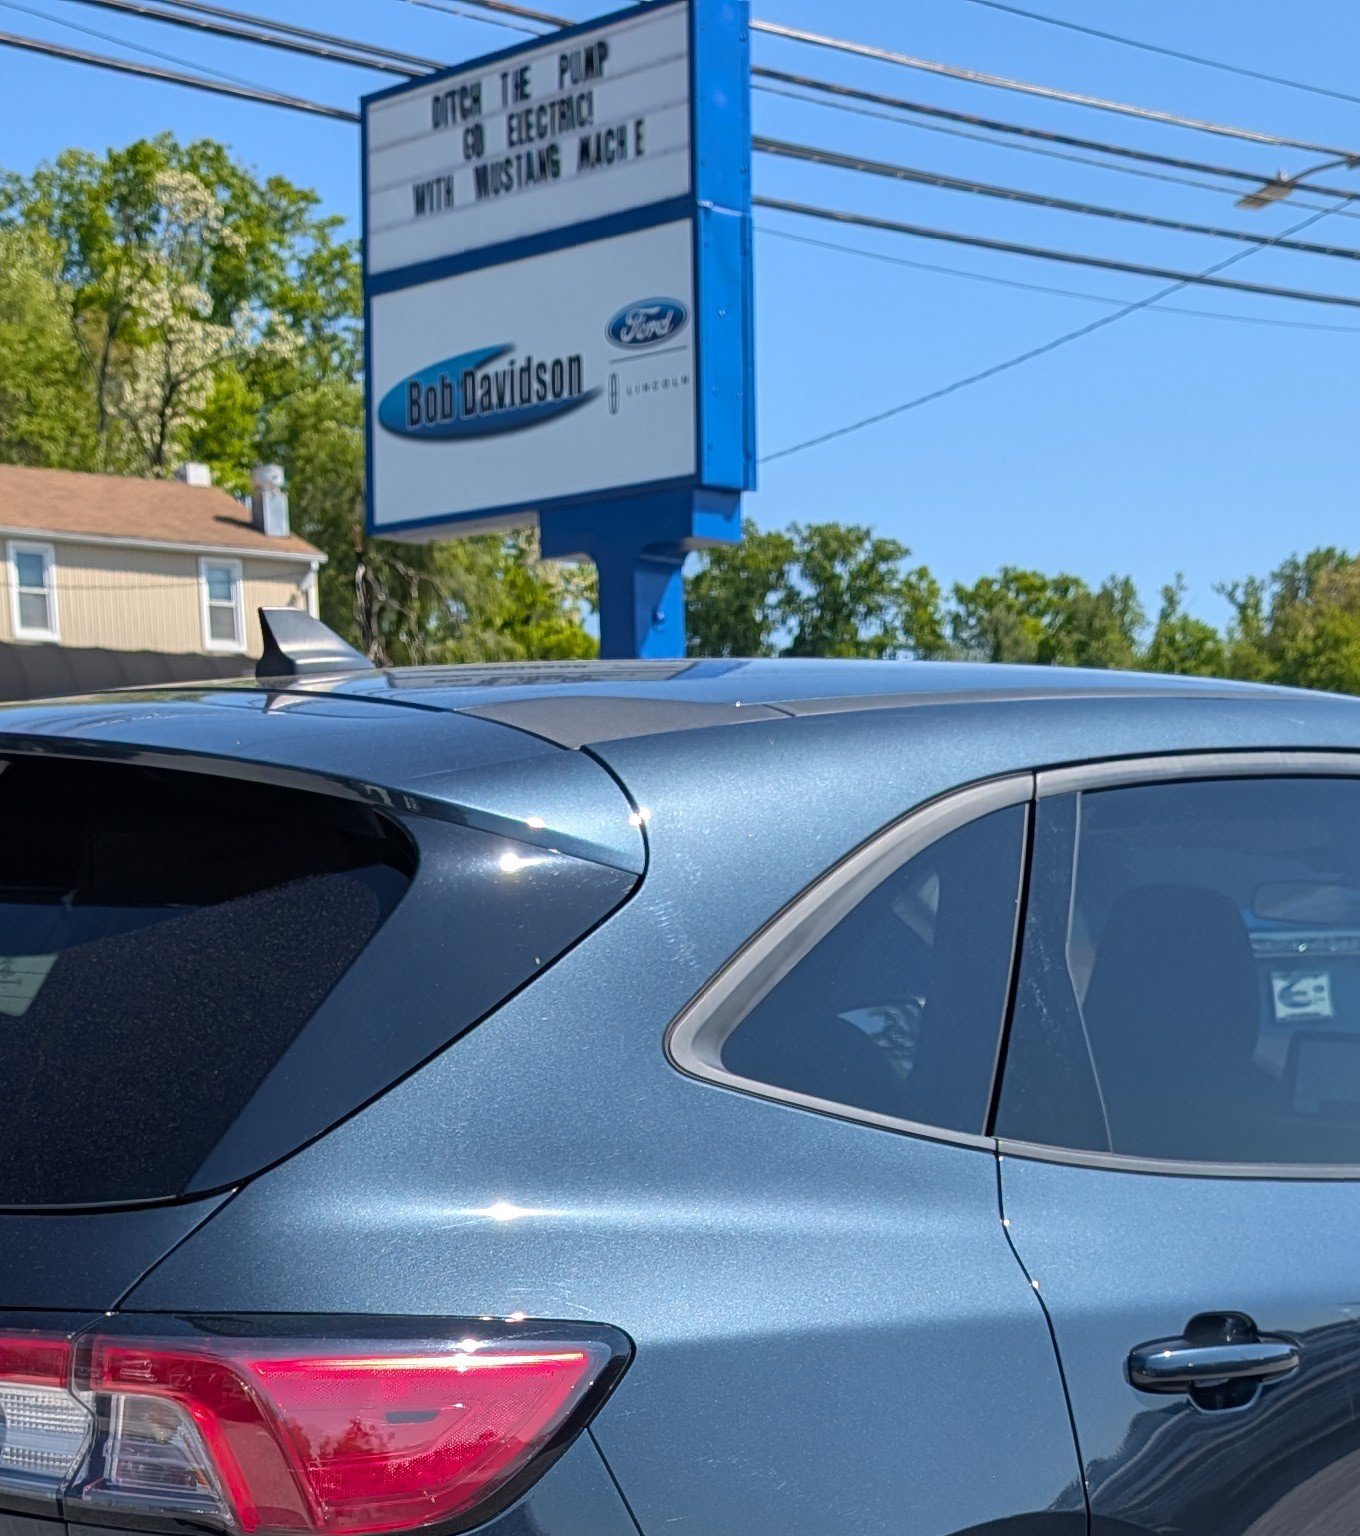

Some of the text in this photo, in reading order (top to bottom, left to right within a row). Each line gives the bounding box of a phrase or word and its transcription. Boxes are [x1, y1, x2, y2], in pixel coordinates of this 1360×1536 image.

[432, 40, 608, 128] DITCH THE PUMP
[413, 118, 644, 216] WITH MUSTANG MACH E
[463, 123, 484, 160] GO
[620, 306, 674, 342] Ford
[407, 353, 584, 428] Bob Davidson
[625, 375, 690, 396] LINCOLN
